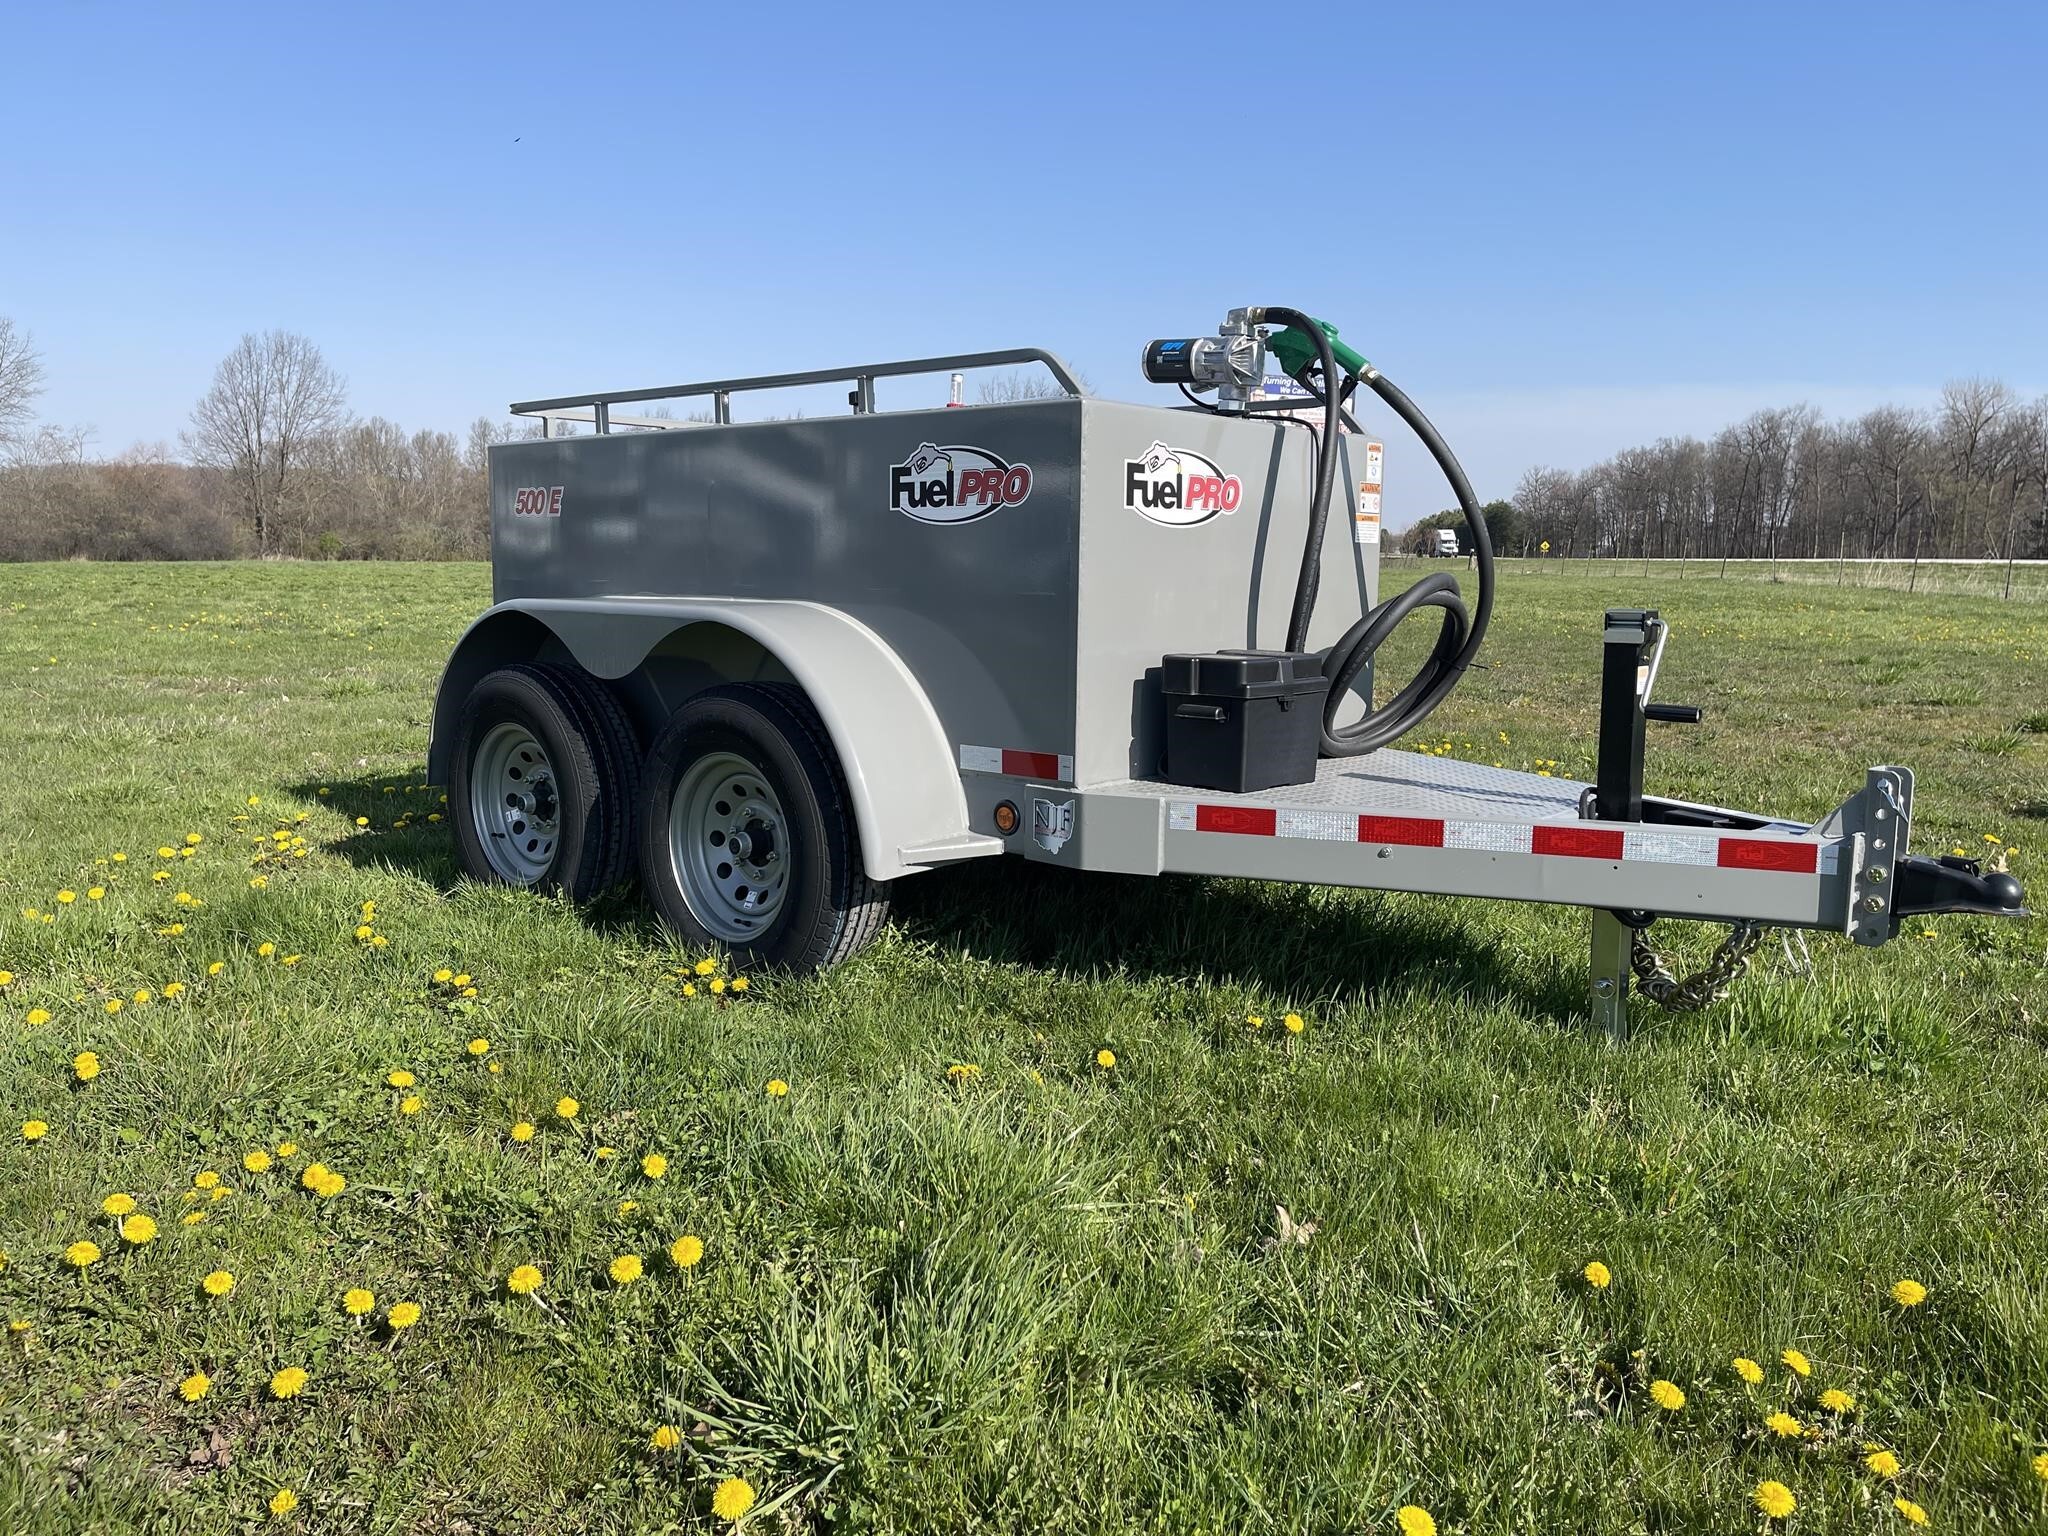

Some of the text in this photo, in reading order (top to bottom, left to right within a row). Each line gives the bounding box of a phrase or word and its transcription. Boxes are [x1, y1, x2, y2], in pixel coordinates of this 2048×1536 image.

[1263, 376, 1295, 387] Turning
[1280, 386, 1291, 394] We
[1291, 387, 1306, 395] Can
[515, 486, 564, 517] 500 E
